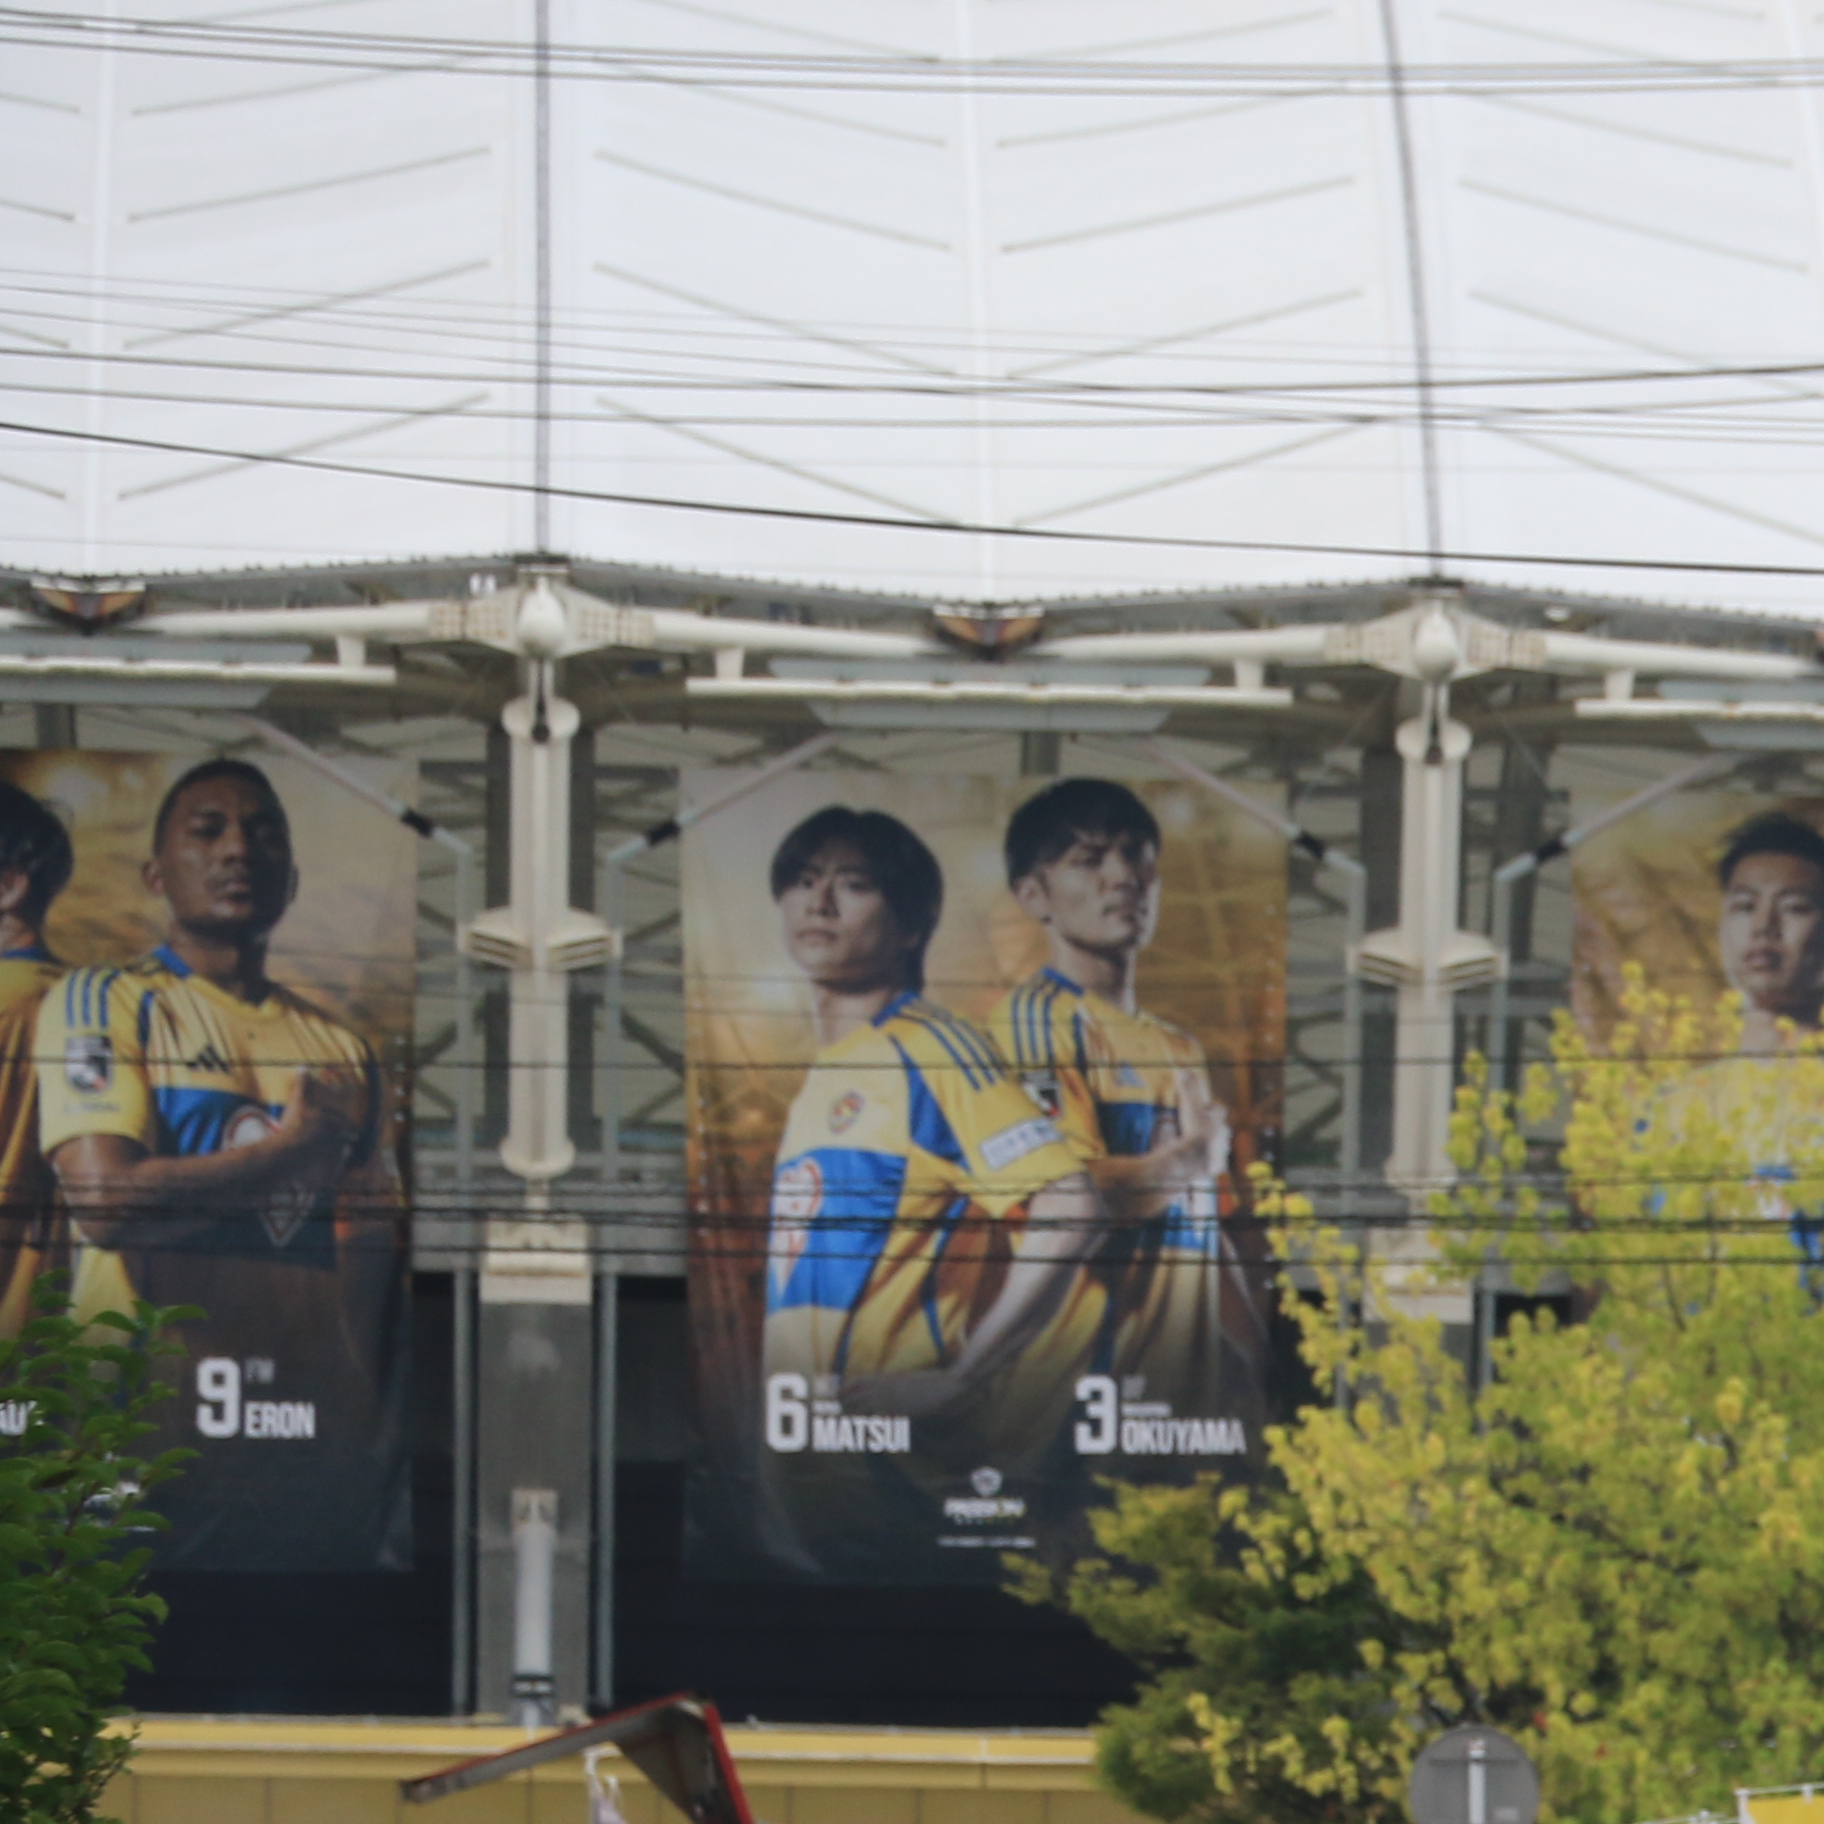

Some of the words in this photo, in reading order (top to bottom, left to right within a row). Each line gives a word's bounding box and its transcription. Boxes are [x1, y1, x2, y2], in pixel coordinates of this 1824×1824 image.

[196, 1356, 241, 1439] 9
[245, 1401, 316, 1439] ERON
[766, 1372, 809, 1454] 6
[812, 1416, 911, 1453] MATSUI
[1074, 1374, 1118, 1455] 3
[1122, 1418, 1248, 1455] OKUYAMA
